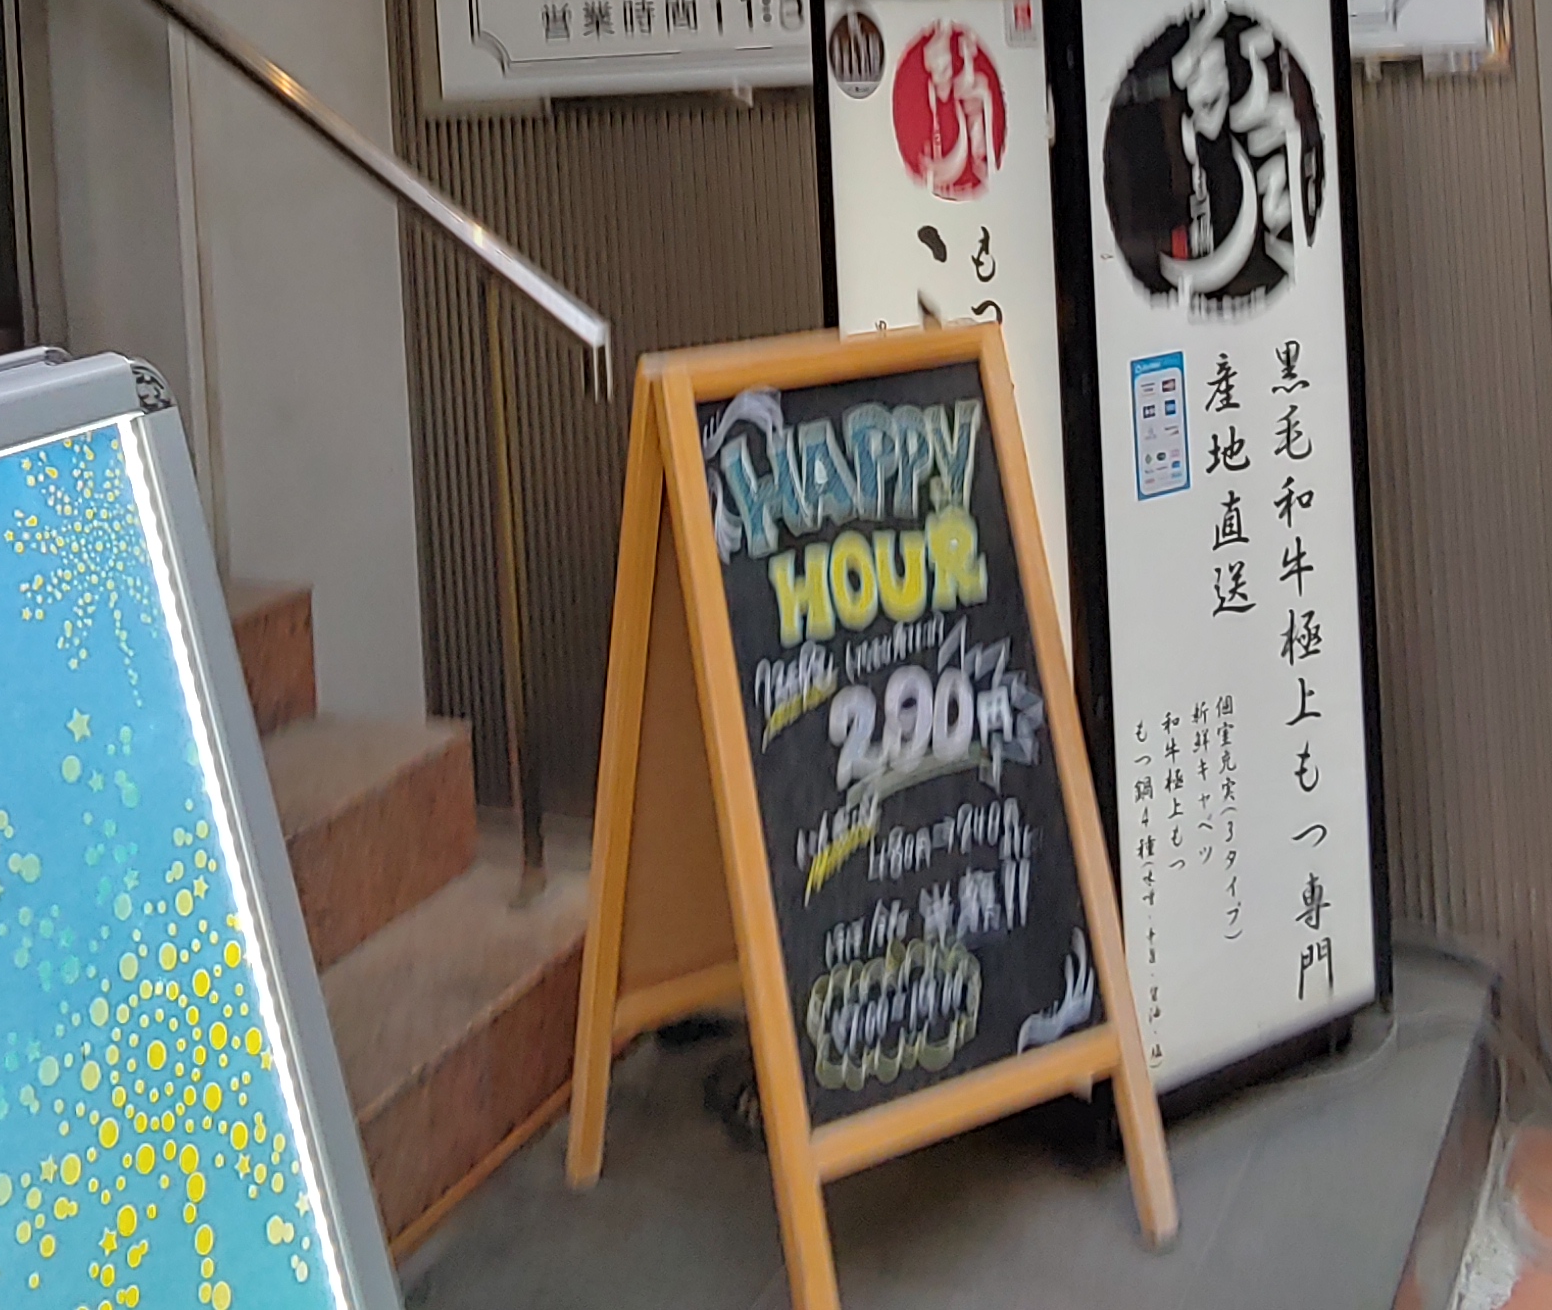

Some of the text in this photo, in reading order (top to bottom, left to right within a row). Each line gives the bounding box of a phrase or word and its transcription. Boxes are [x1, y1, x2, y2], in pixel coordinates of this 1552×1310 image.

[720, 399, 982, 560] HAPPY
[1204, 352, 1257, 618] 産地直送
[768, 503, 988, 648] HOUR
[1271, 339, 1335, 1001] 黒毛和牛極上もつ専門
[1160, 711, 1187, 870] 和牛極上もつ
